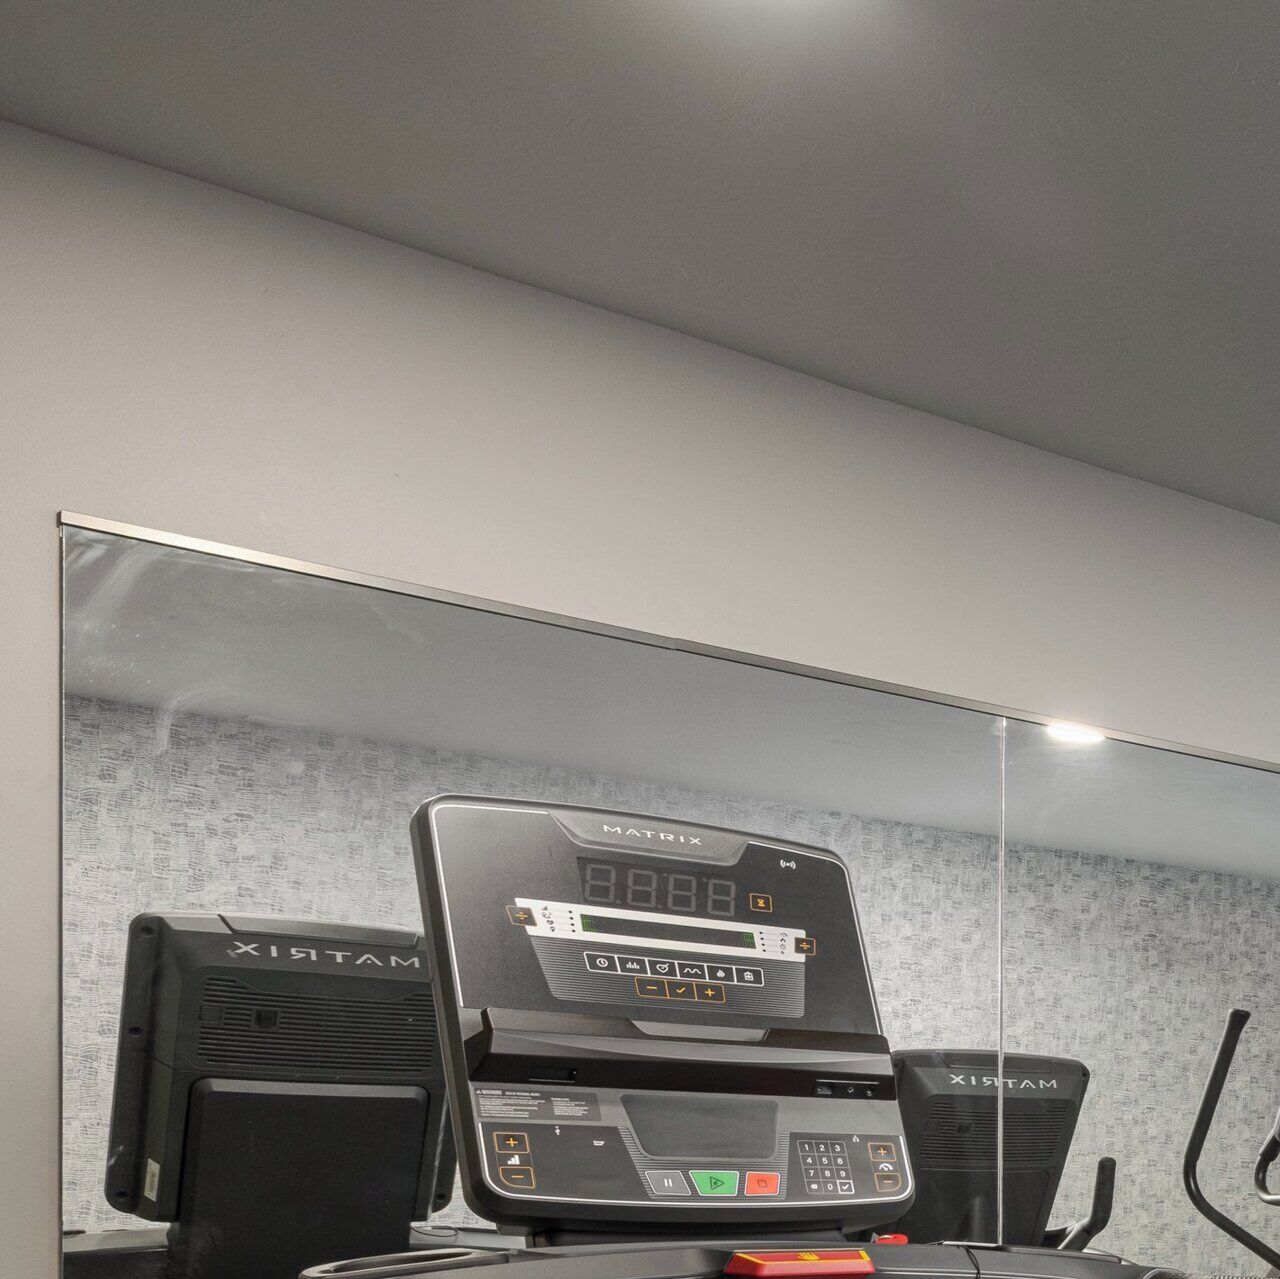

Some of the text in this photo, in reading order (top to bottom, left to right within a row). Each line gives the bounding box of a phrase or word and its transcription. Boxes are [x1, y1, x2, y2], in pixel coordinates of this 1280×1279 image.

[603, 825, 702, 846] MATRIX
[834, 1144, 841, 1152] 3
[822, 1157, 829, 1165] 5
[837, 1157, 844, 1165] 6
[809, 1169, 846, 1178] 7 8 9
[827, 1183, 834, 1191] 0
